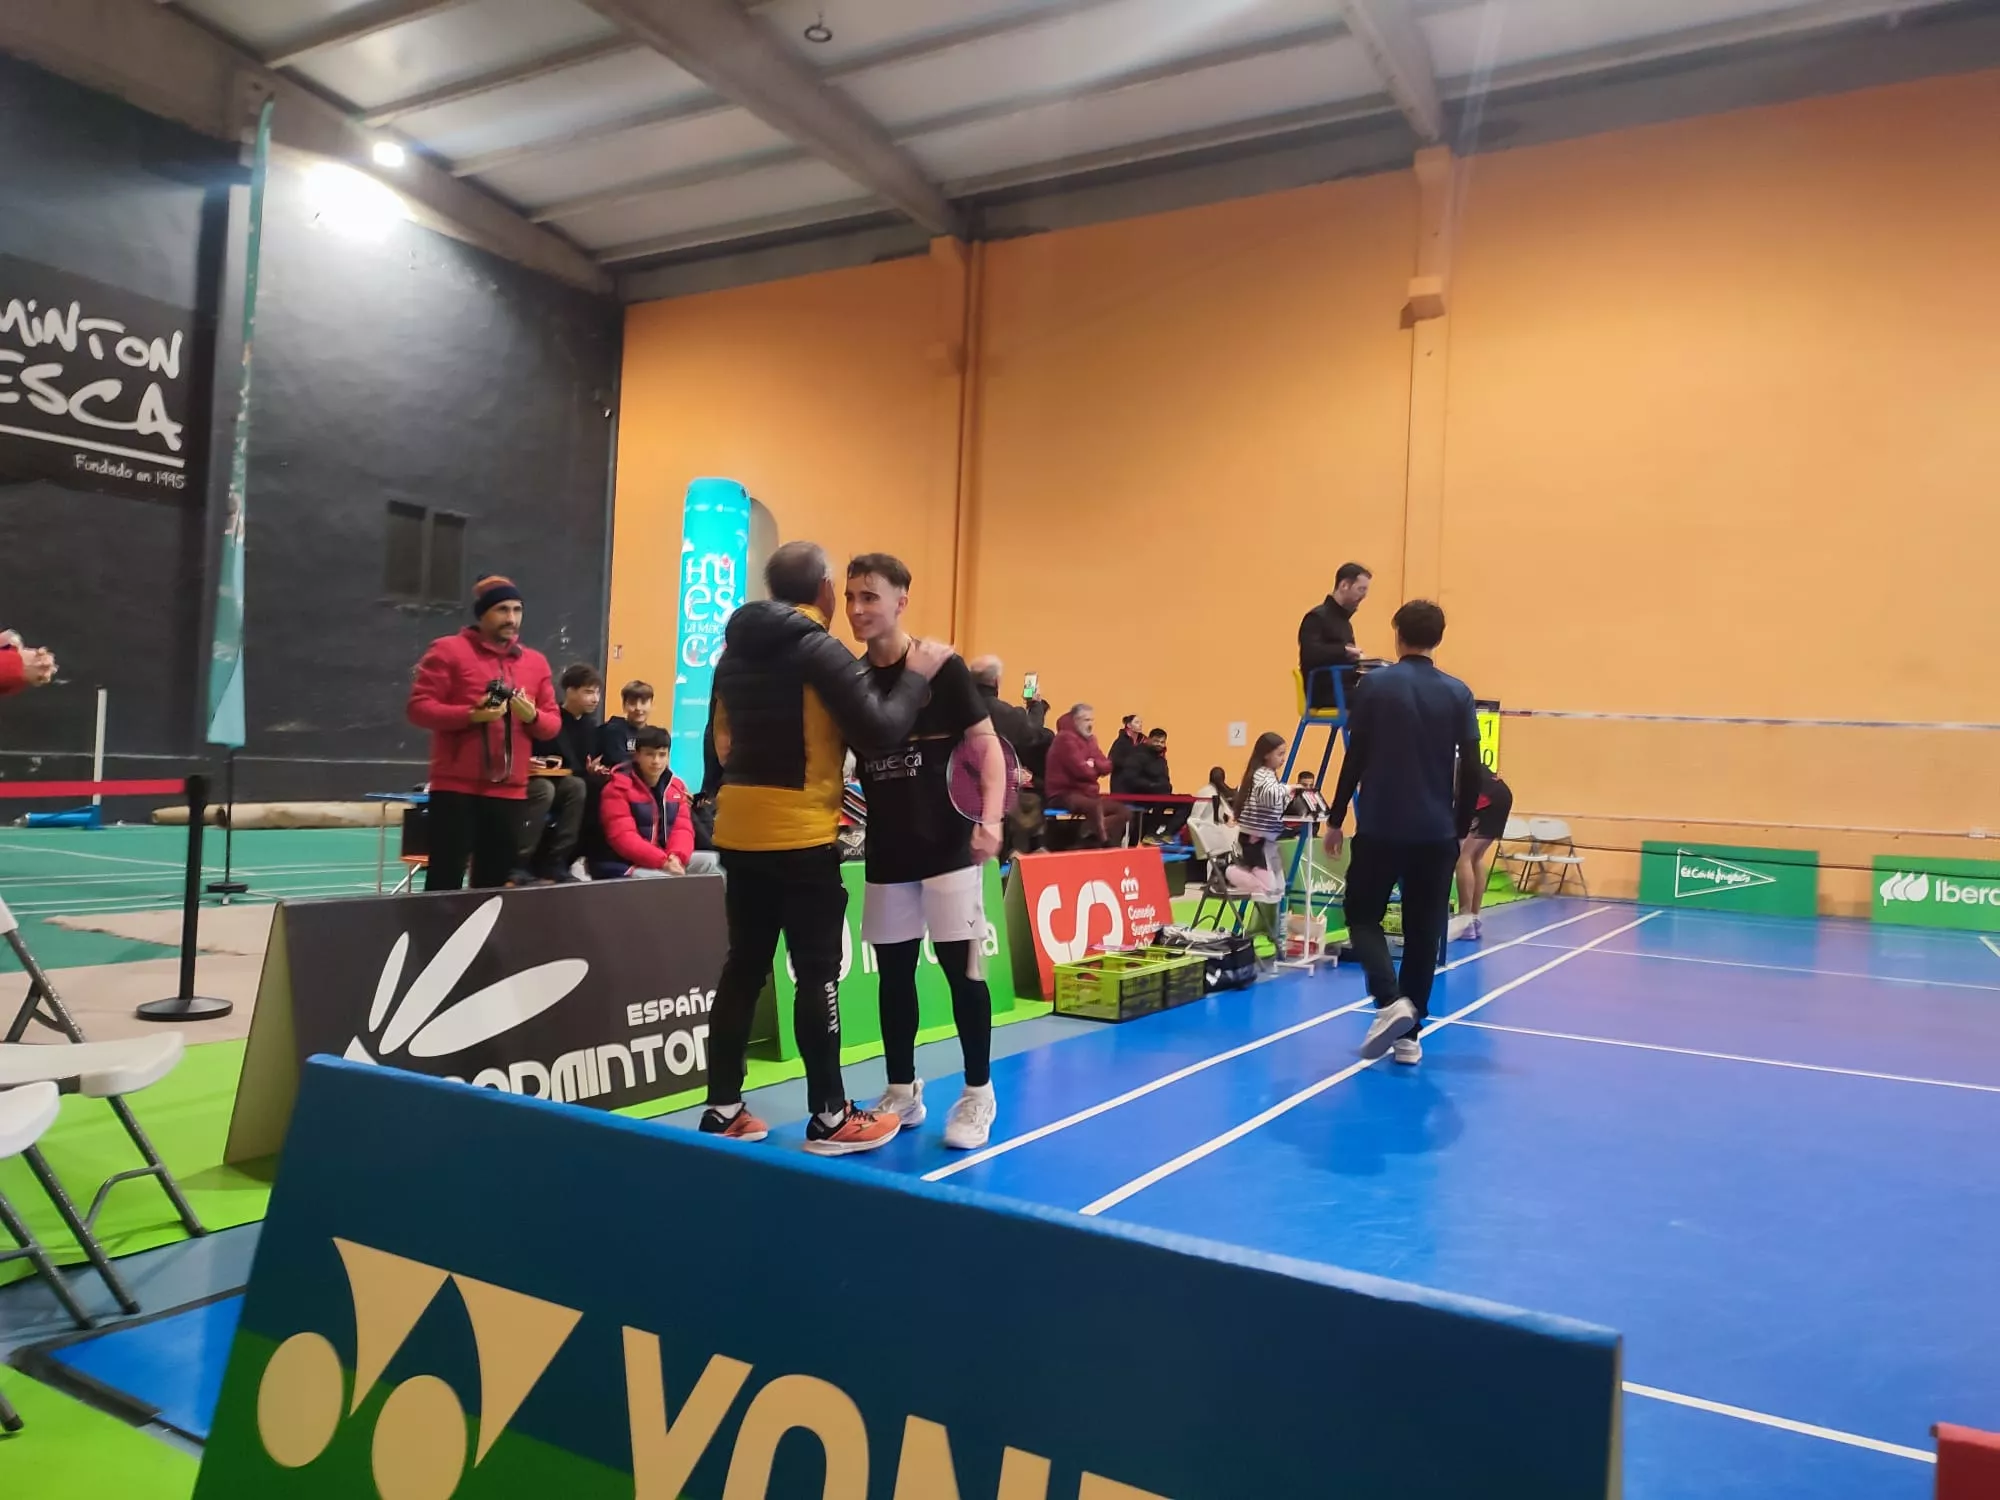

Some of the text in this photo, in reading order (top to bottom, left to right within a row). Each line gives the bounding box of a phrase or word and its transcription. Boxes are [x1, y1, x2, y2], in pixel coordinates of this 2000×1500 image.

[74, 453, 185, 489] Fundado en 1995
[1484, 720, 1492, 737] 1
